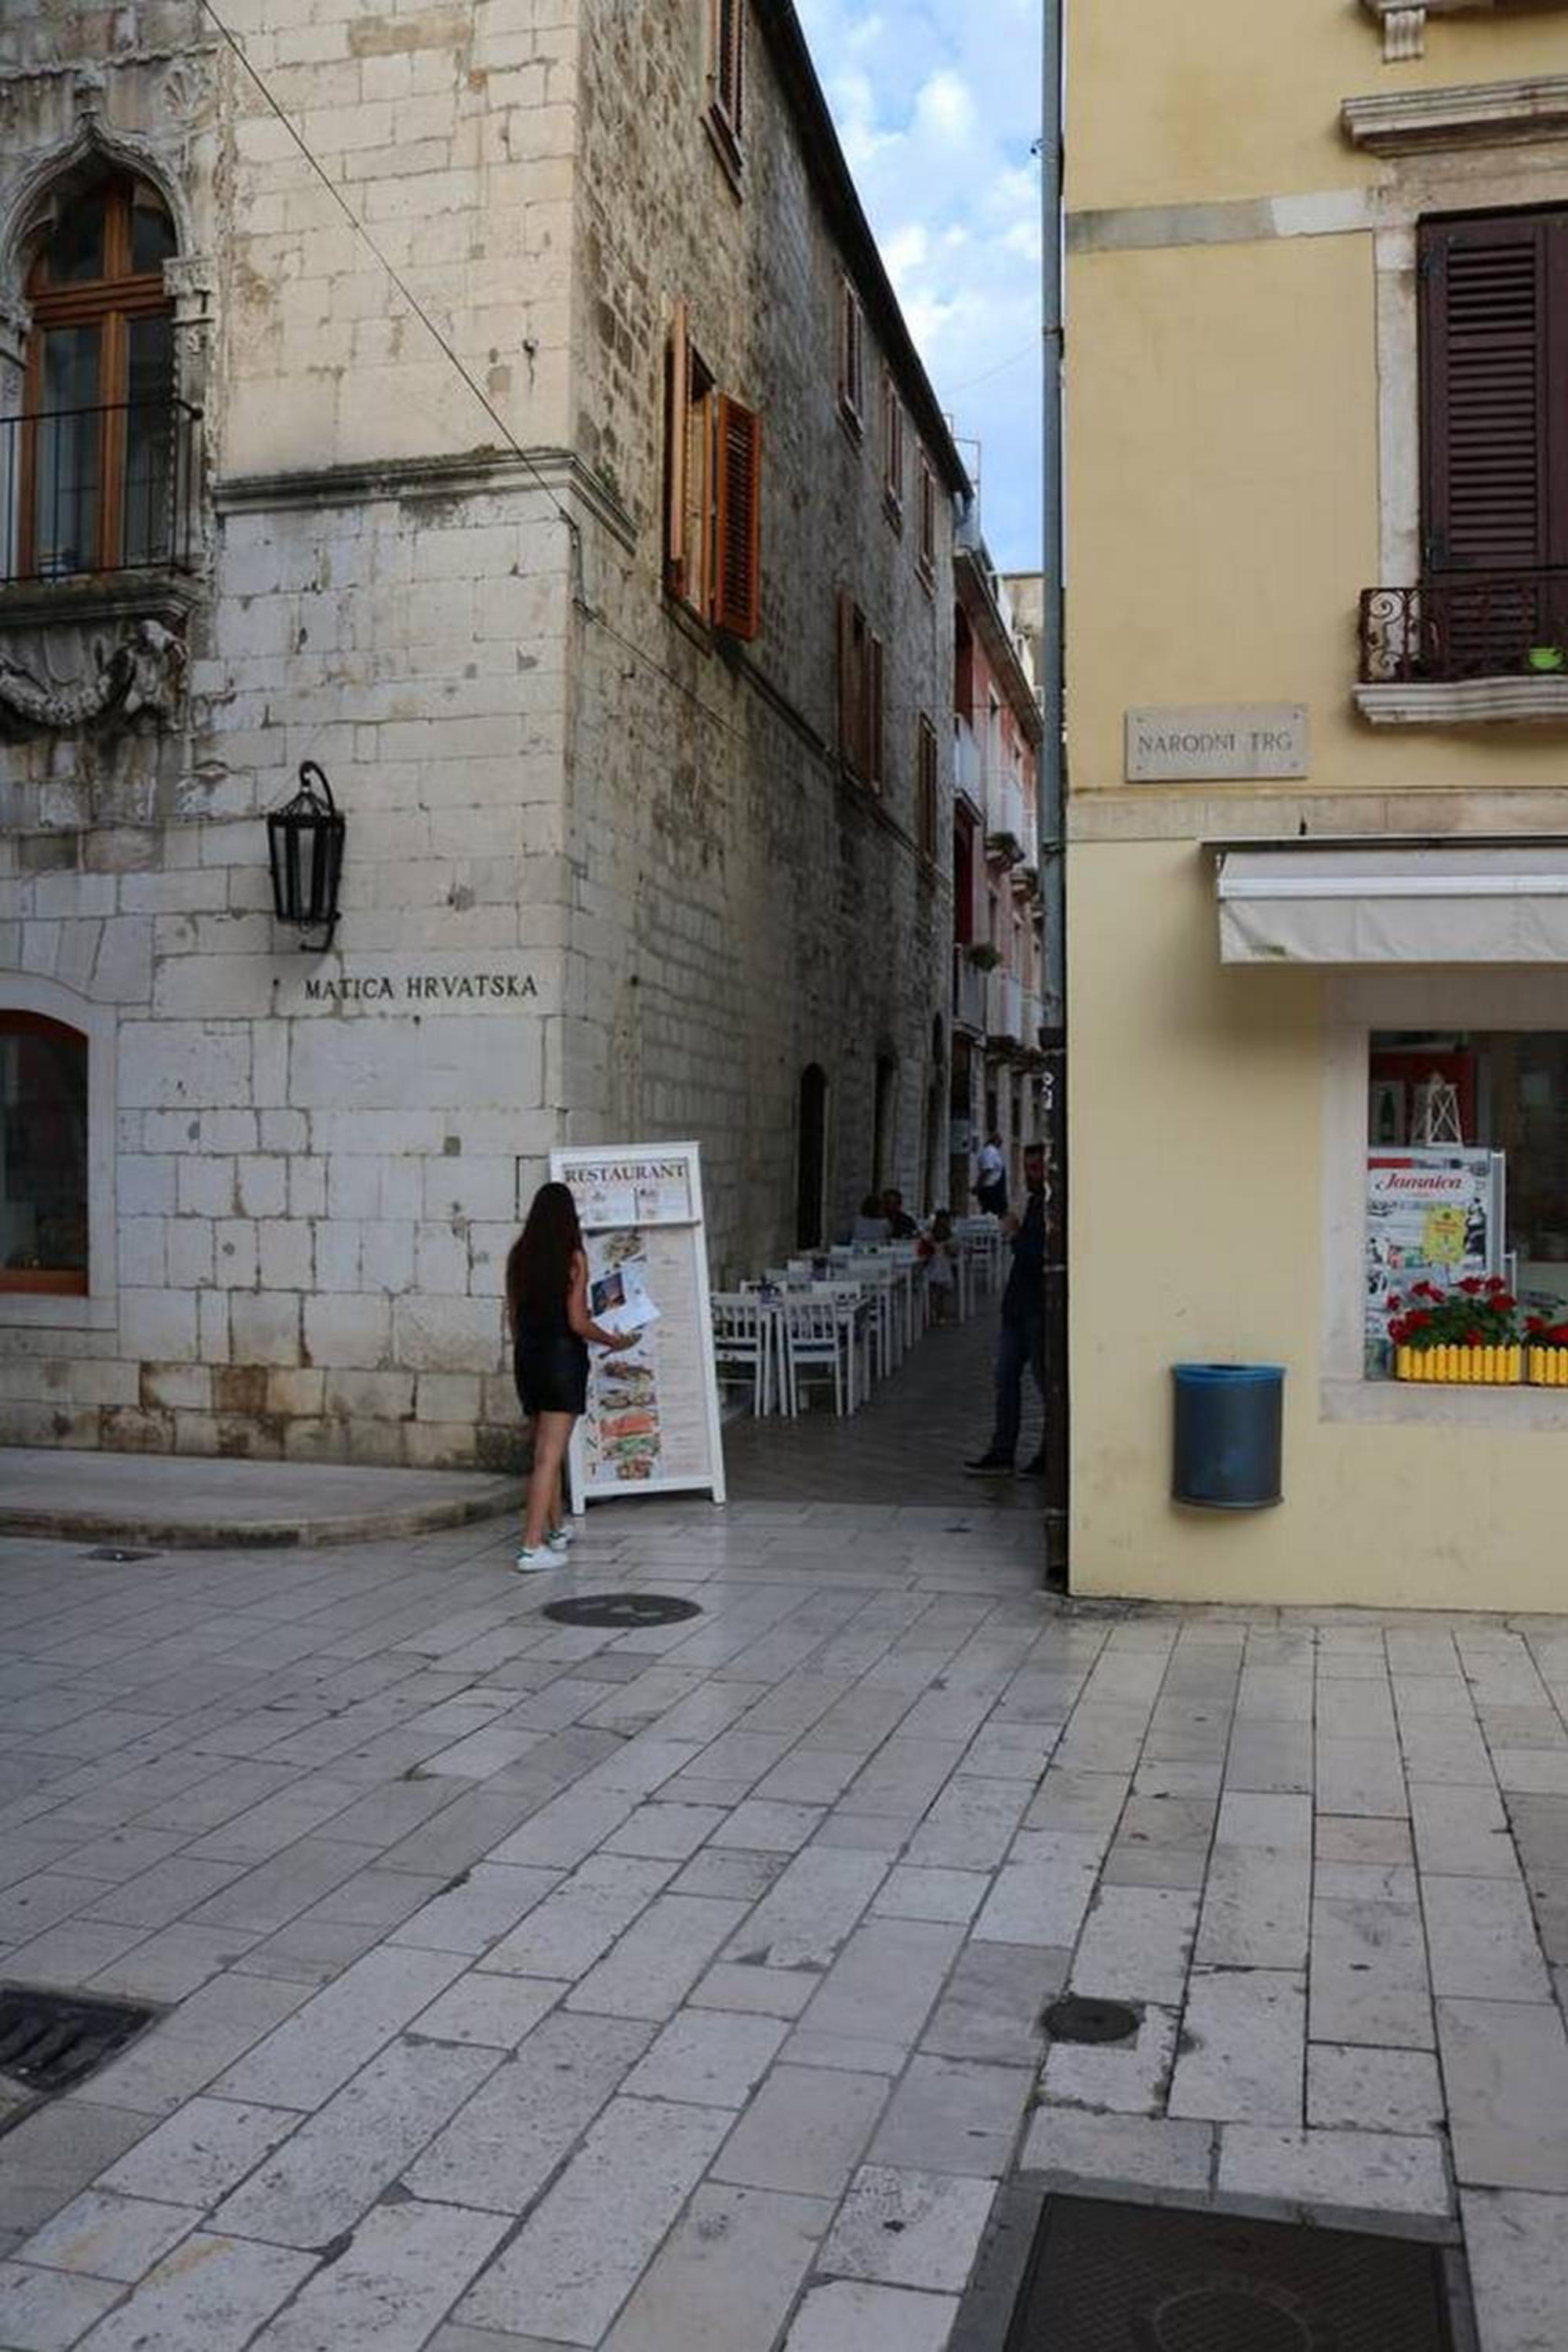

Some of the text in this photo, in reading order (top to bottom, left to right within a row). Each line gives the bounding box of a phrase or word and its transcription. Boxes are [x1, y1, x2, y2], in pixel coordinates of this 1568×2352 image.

[1138, 731, 1292, 753] NARODNI TRG
[305, 975, 538, 1000] MATICA HRVATSKA
[564, 1164, 685, 1182] RESTAURANT
[1382, 1173, 1463, 1190] Jamaica
